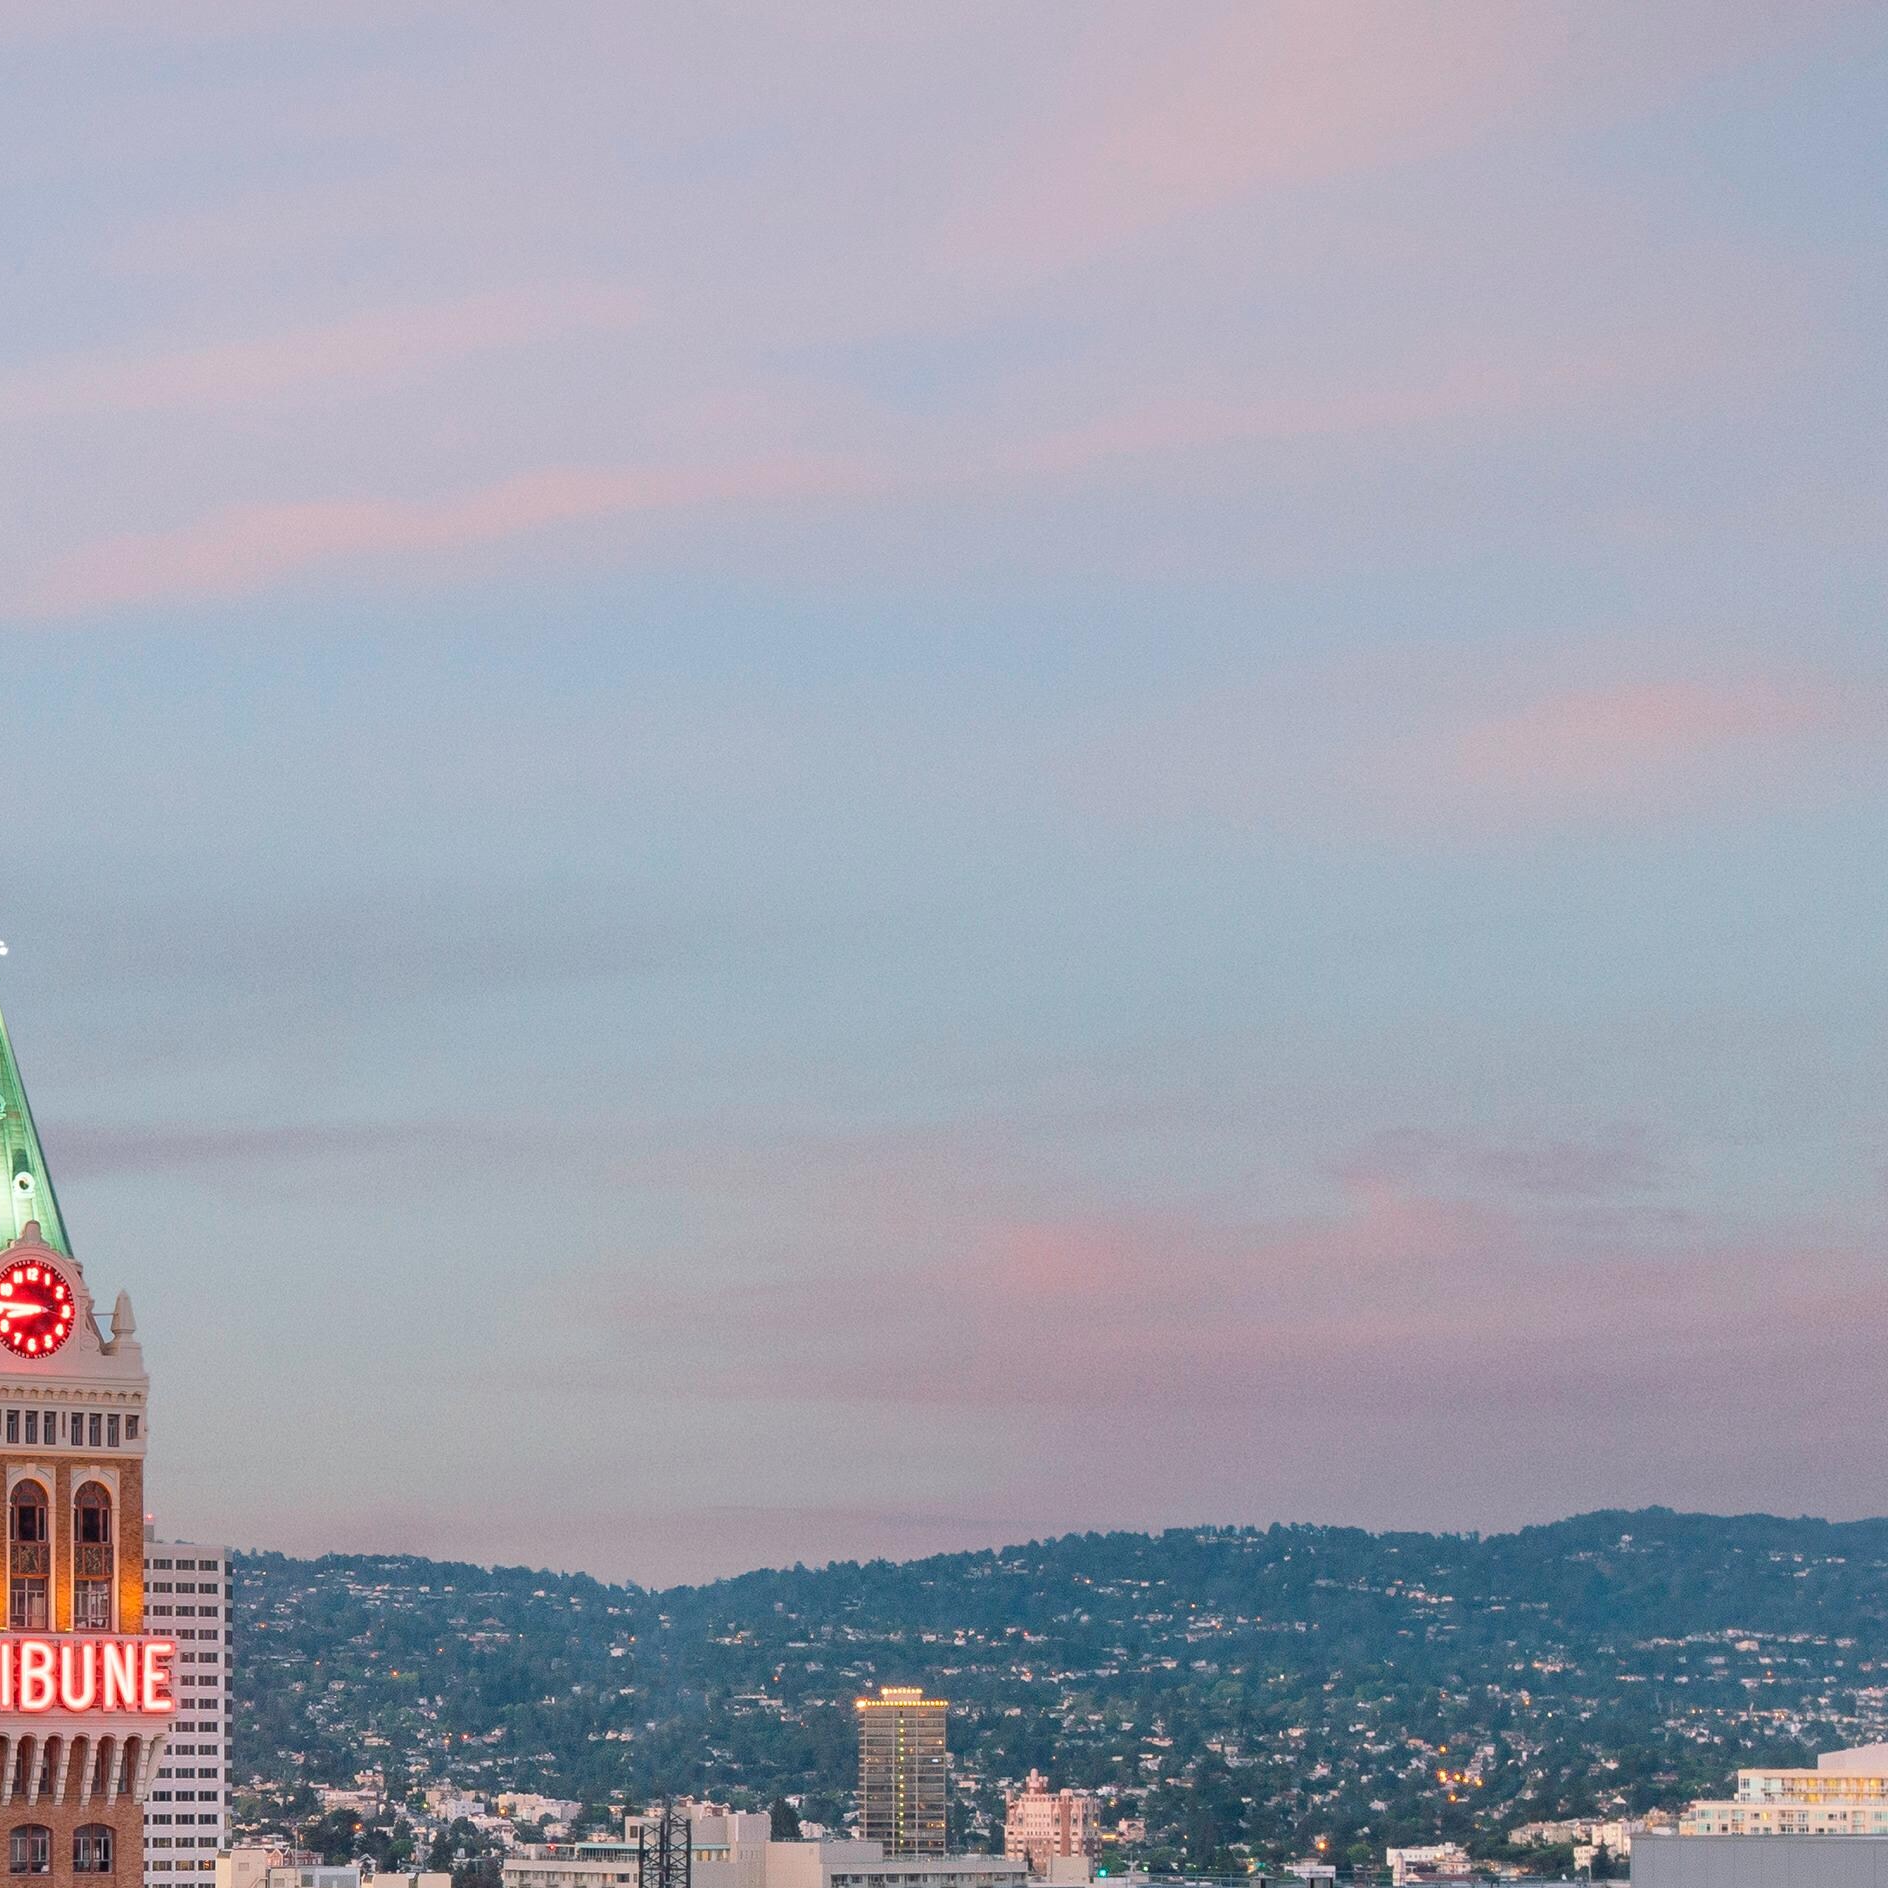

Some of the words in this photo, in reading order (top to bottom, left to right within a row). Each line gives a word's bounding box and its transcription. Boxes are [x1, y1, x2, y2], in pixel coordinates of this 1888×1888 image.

[27, 1267, 39, 1281] 12
[55, 1286, 64, 1299] 2
[14, 1332, 22, 1345] 7
